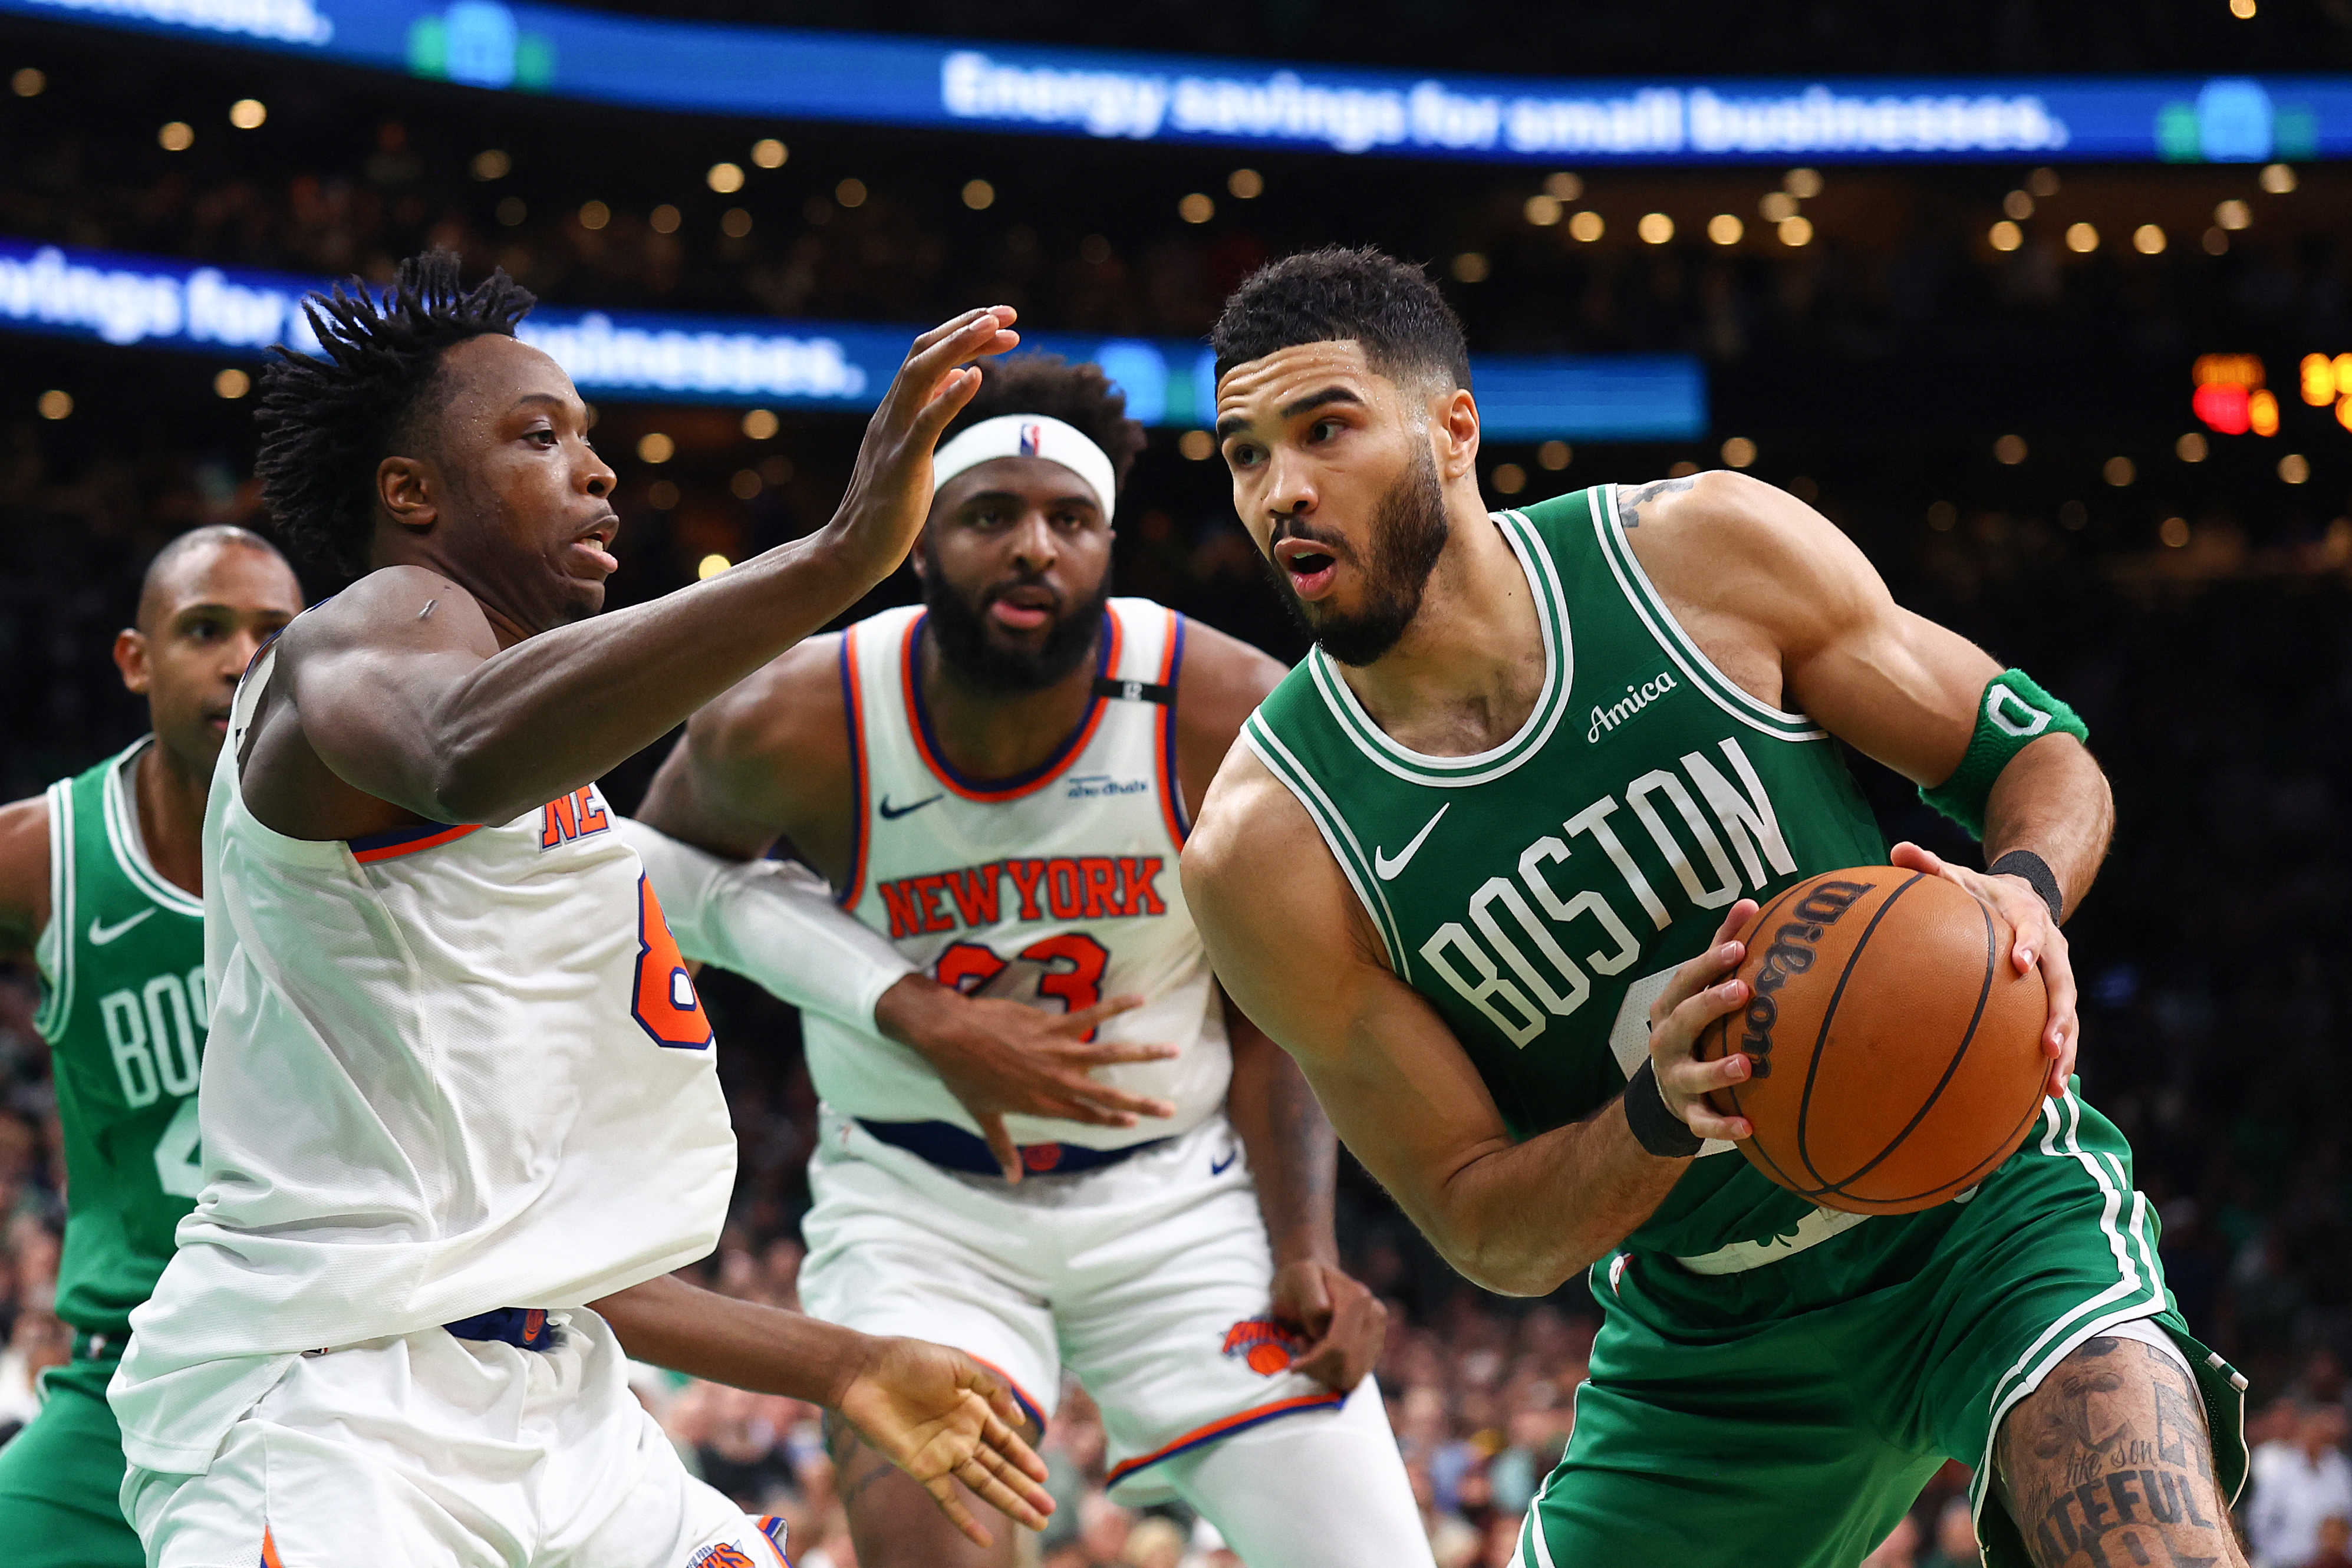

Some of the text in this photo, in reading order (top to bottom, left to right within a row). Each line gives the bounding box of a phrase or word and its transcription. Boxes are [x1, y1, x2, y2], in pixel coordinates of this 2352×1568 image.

[1587, 671, 1678, 744] Amica
[878, 855, 1166, 939] NEW YORK
[1418, 736, 1798, 1050] BOSTON
[1740, 880, 1877, 1079] Wilson
